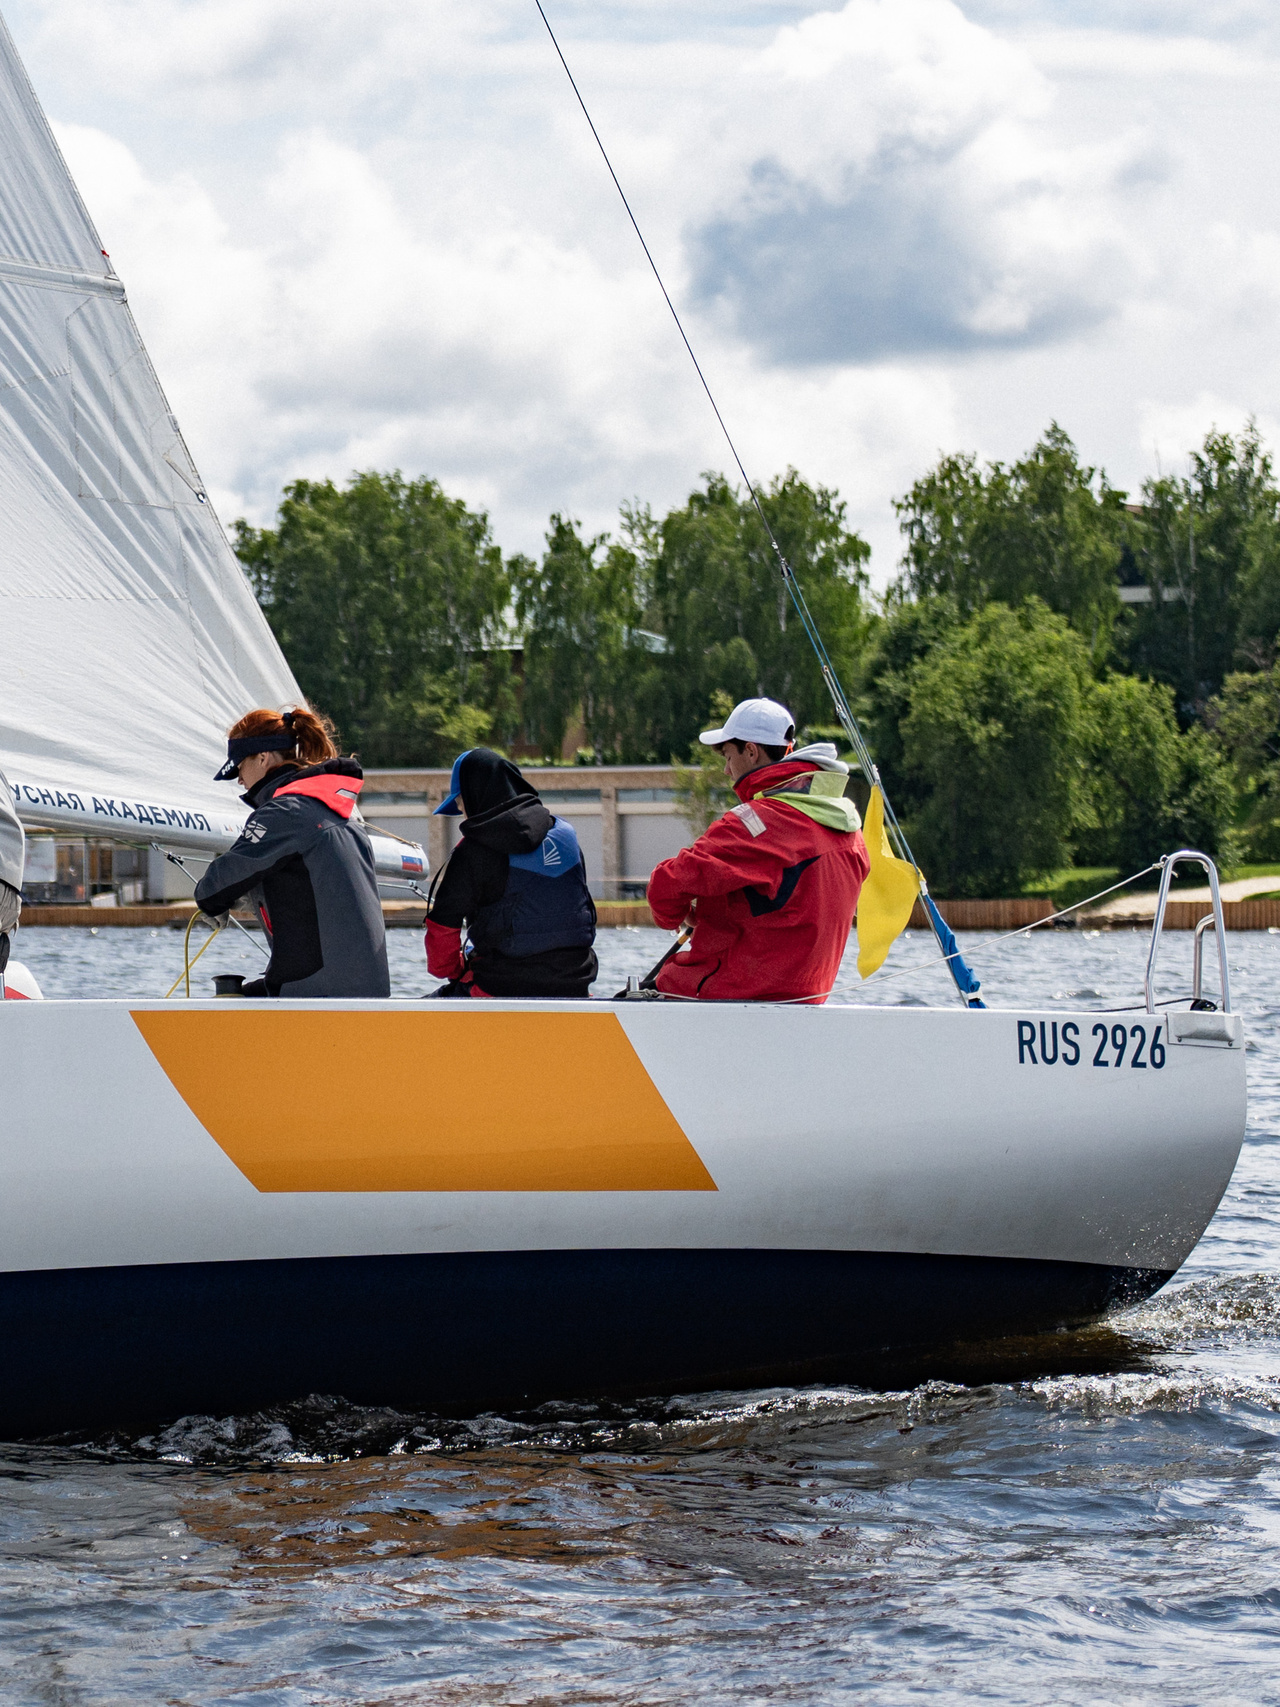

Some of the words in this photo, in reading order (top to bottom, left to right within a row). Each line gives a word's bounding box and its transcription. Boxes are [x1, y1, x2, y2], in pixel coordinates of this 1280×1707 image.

[10, 784, 85, 811] УСНАЯ
[93, 796, 212, 832] АКАДЕМИЯ
[1017, 1020, 1080, 1066] RUS
[1091, 1022, 1166, 1069] 2926
